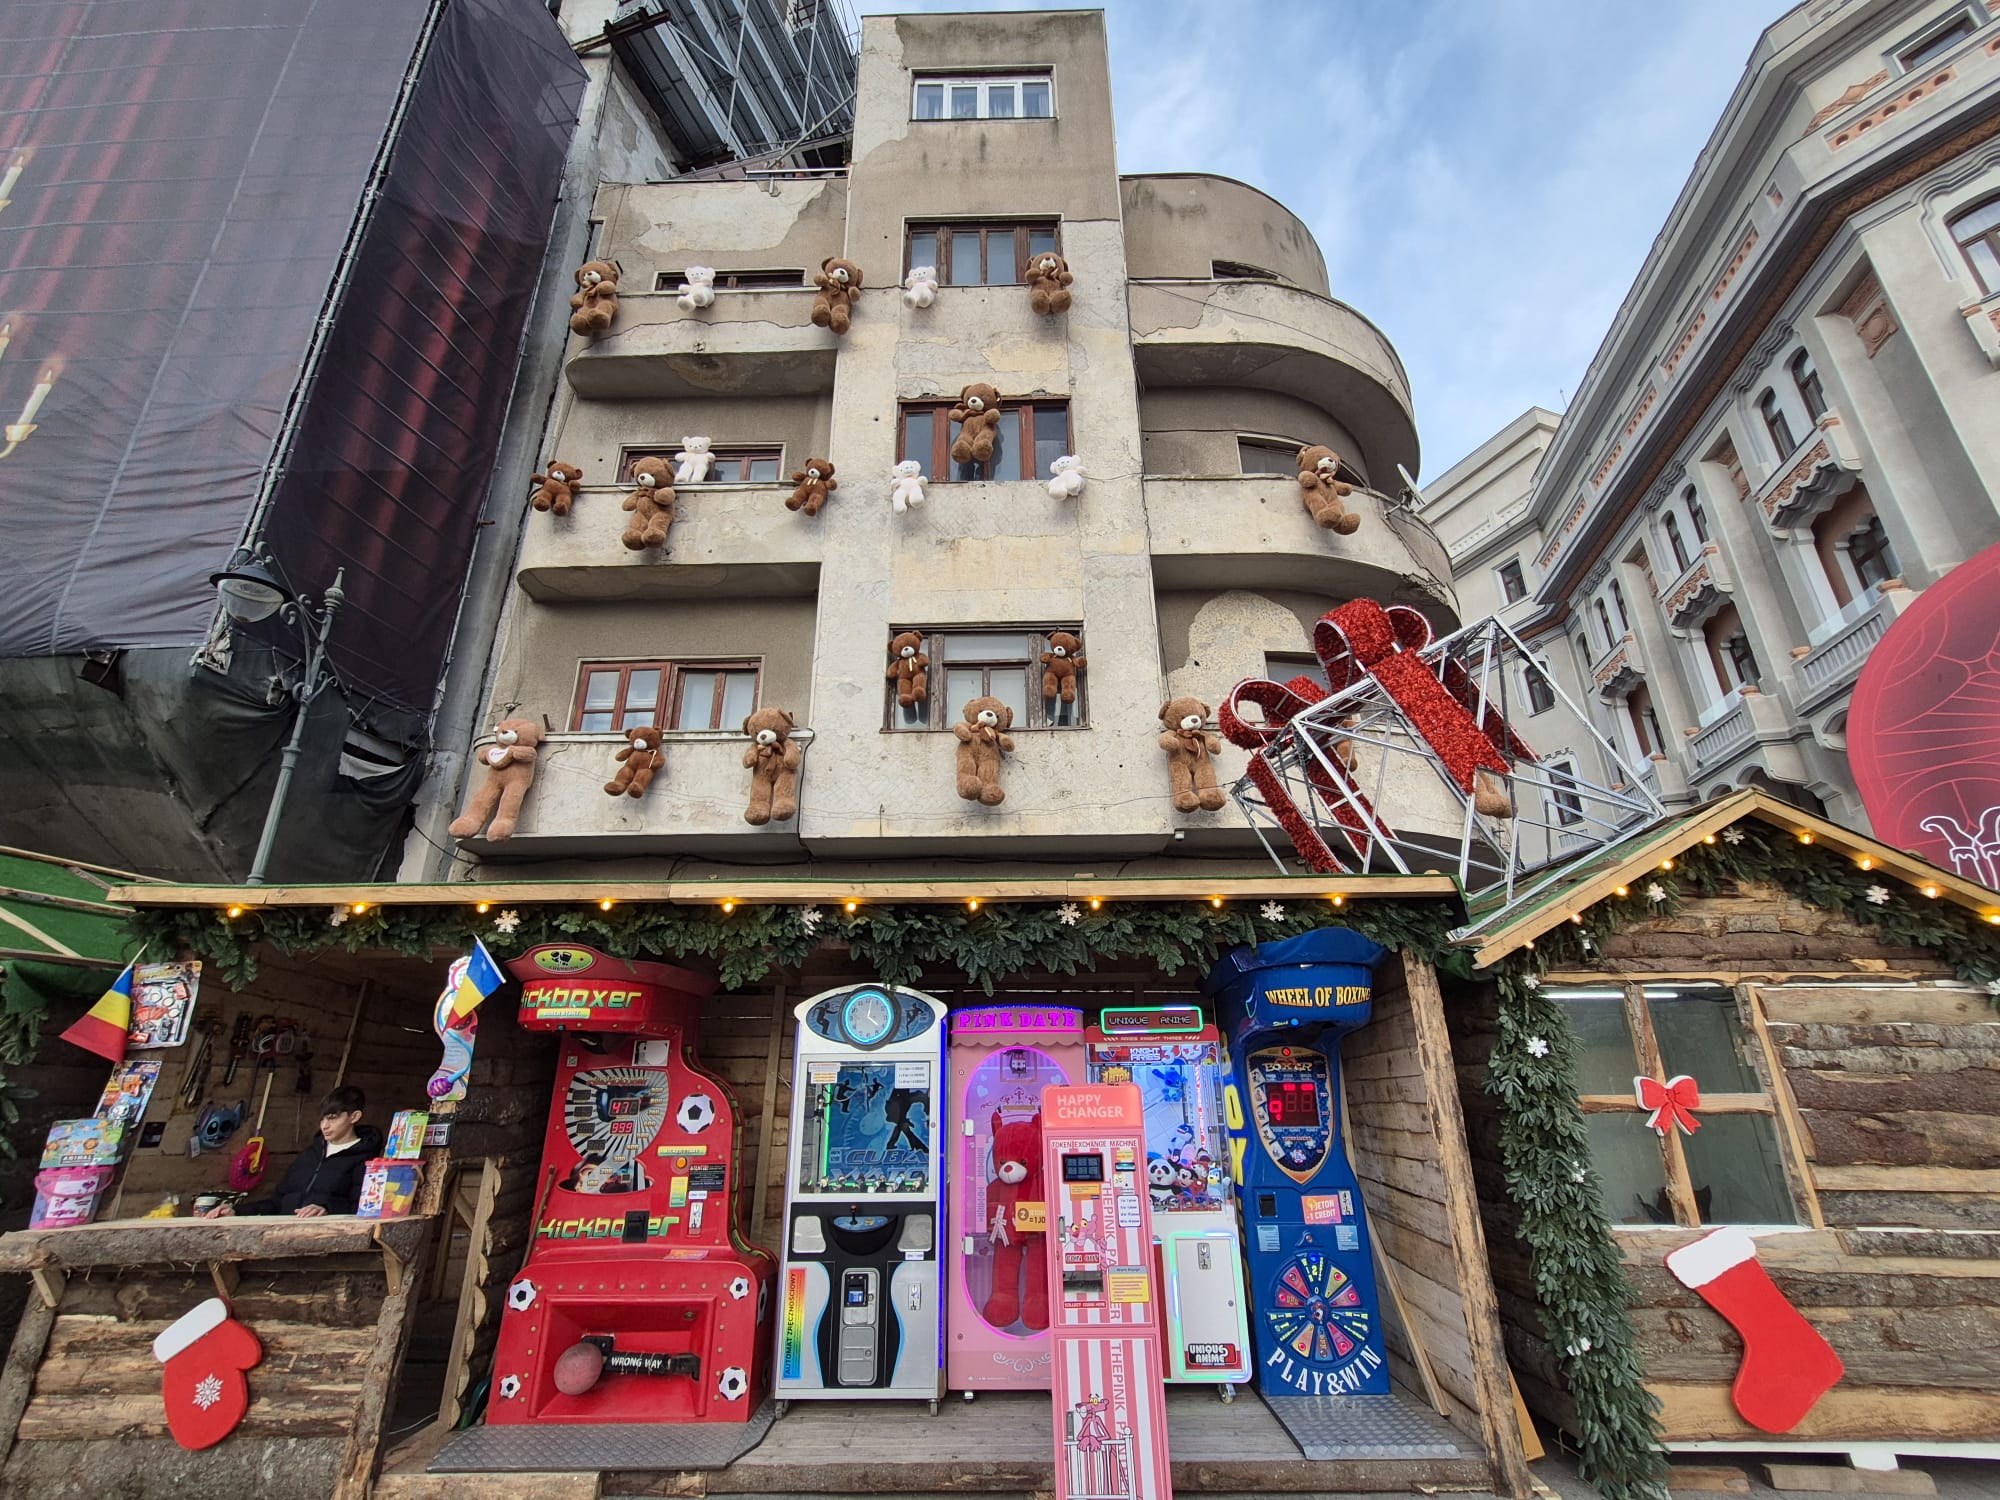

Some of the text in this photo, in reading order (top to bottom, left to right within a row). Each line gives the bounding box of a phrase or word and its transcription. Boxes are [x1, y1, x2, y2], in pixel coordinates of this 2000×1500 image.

[1265, 986, 1371, 1008] WHEEL OF BOXING
[959, 1012, 1076, 1027] PINK DATE
[1109, 1015, 1192, 1025] UNIQUE ANIME
[1057, 1094, 1102, 1106] HAPPY
[1057, 1106, 1124, 1119] CHANGER
[612, 1122, 633, 1133] 999
[1074, 1140, 1107, 1148] EXCHANGE
[846, 1149, 930, 1165] CUBA
[1314, 1199, 1335, 1210] JETON
[1315, 1208, 1337, 1220] CREDIT
[535, 1216, 680, 1239] Kickboer
[1106, 1249, 1121, 1320] PAER
[784, 1338, 794, 1375] AUTOMAT
[1189, 1344, 1229, 1356] UNIQUE
[611, 1356, 662, 1369] WRONG WAY
